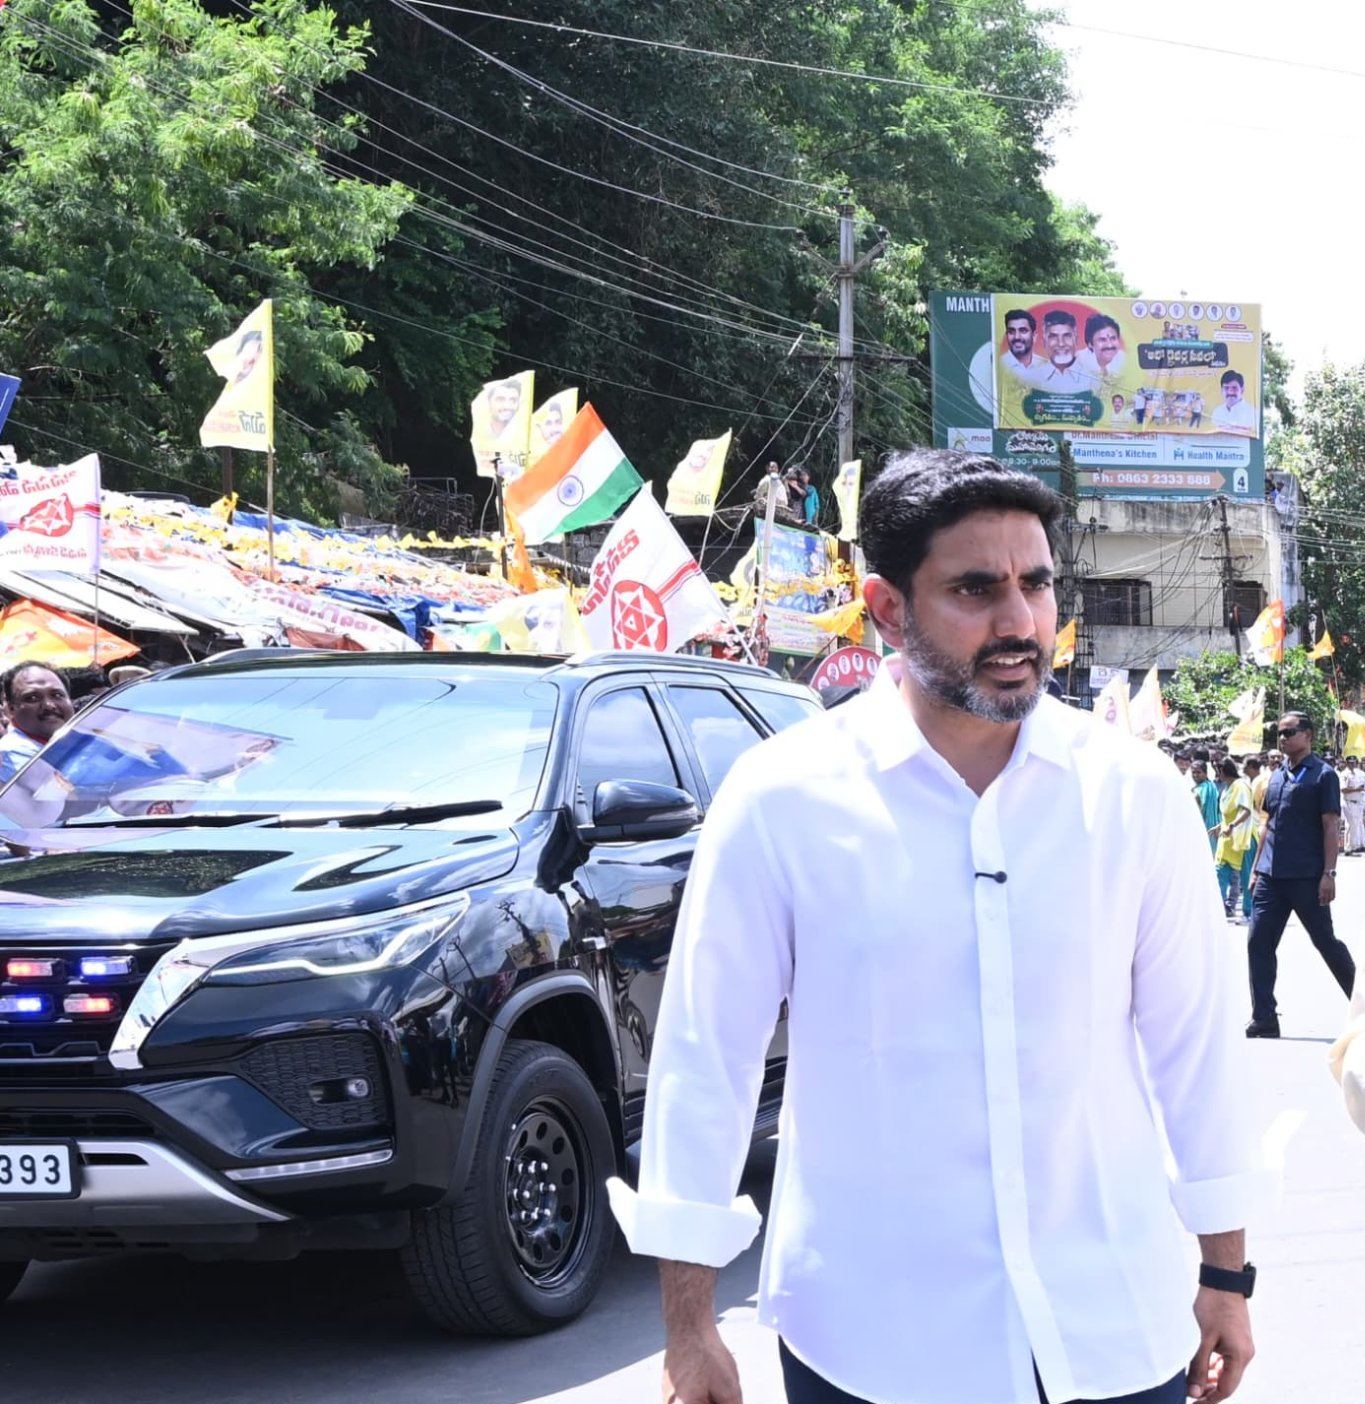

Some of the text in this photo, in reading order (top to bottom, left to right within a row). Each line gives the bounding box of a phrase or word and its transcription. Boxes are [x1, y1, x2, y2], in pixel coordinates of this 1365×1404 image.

[946, 296, 990, 313] MANTH
[1074, 449, 1158, 459] Manthena's Kitchen
[1187, 451, 1245, 461] Health Mantra
[1092, 472, 1113, 484] Ph:
[1118, 473, 1148, 484] 0863
[1152, 474, 1184, 485] 2333
[1237, 475, 1246, 487] 4
[0, 1154, 60, 1185] 393
